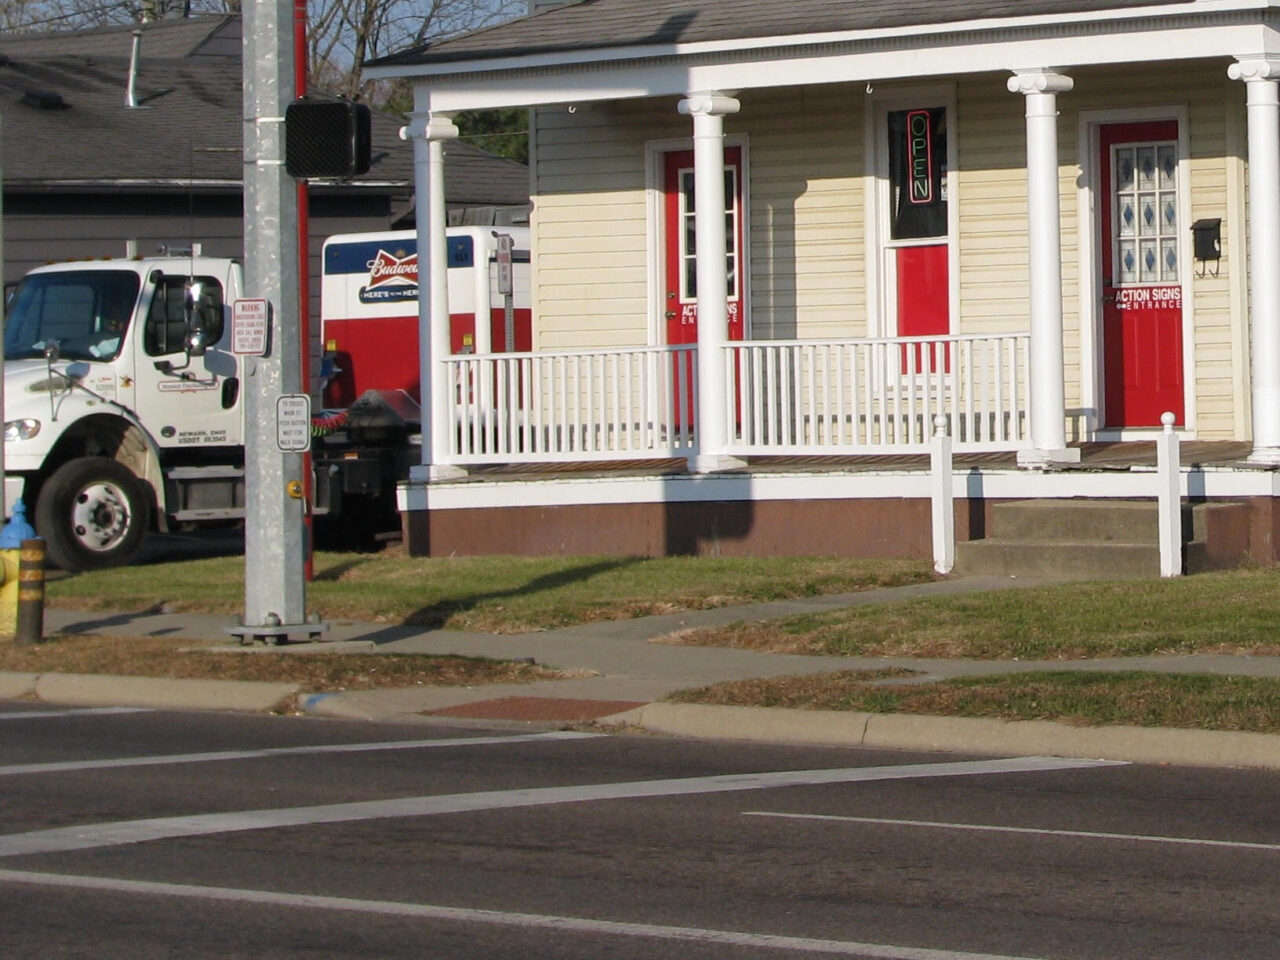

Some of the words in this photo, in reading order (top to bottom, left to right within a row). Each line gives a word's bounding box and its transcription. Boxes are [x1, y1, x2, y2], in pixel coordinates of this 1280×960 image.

[911, 116, 928, 198] OPEN
[1115, 289, 1150, 302] ACTION
[1152, 288, 1181, 301] SIGNS
[1126, 300, 1181, 311] ENTRANCE
